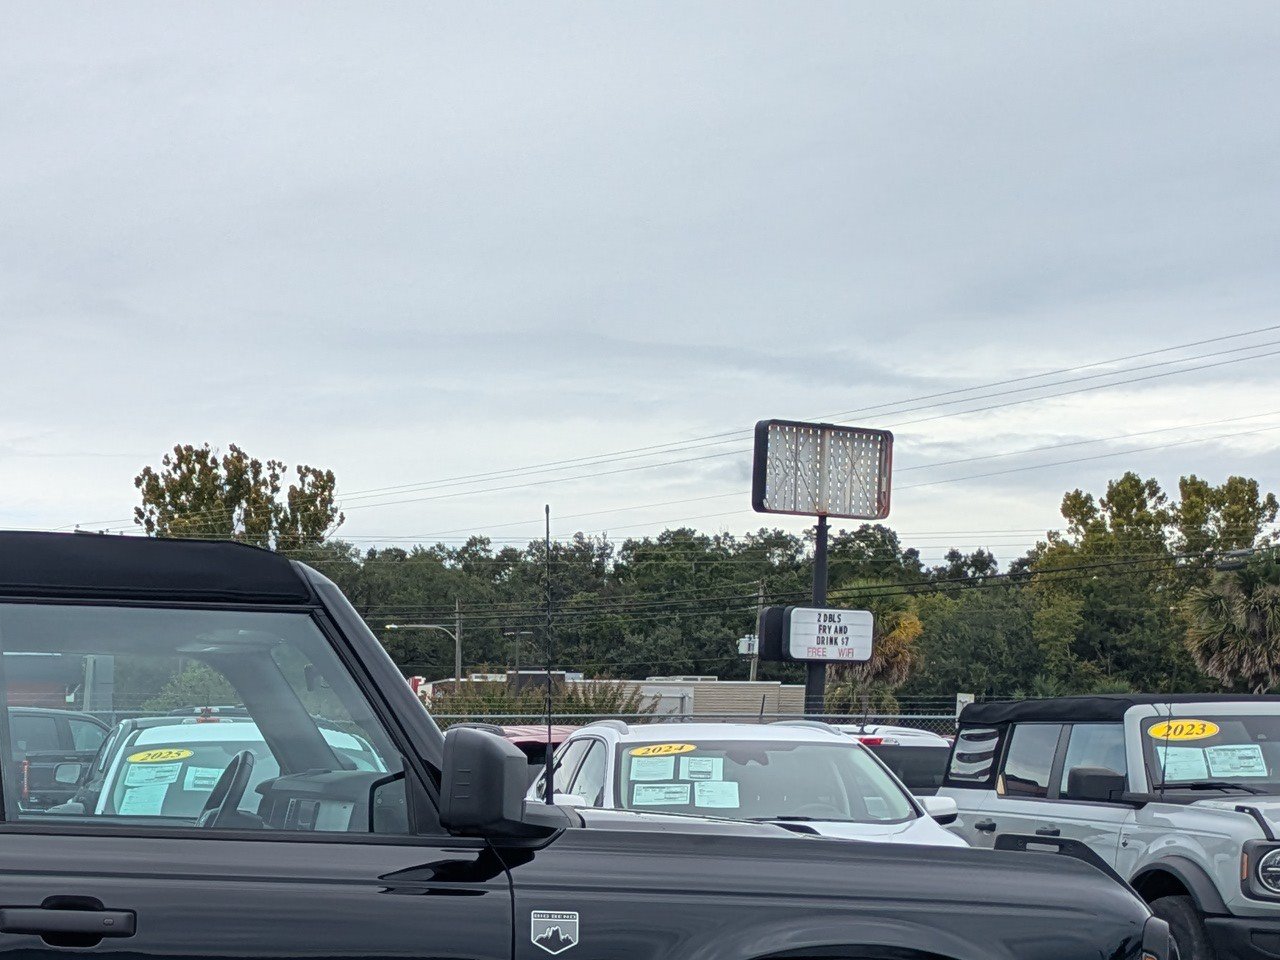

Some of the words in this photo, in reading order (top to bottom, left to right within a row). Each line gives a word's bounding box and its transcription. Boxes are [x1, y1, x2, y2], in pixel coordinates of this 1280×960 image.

[823, 613, 842, 623] DBLS
[818, 625, 832, 635] FRY
[834, 626, 848, 635] AND
[816, 636, 839, 646] DRINK
[841, 637, 850, 646] $7
[807, 647, 827, 658] FREE
[1161, 723, 1207, 738] 2023
[641, 745, 686, 755] 2024
[139, 750, 184, 762] 2025
